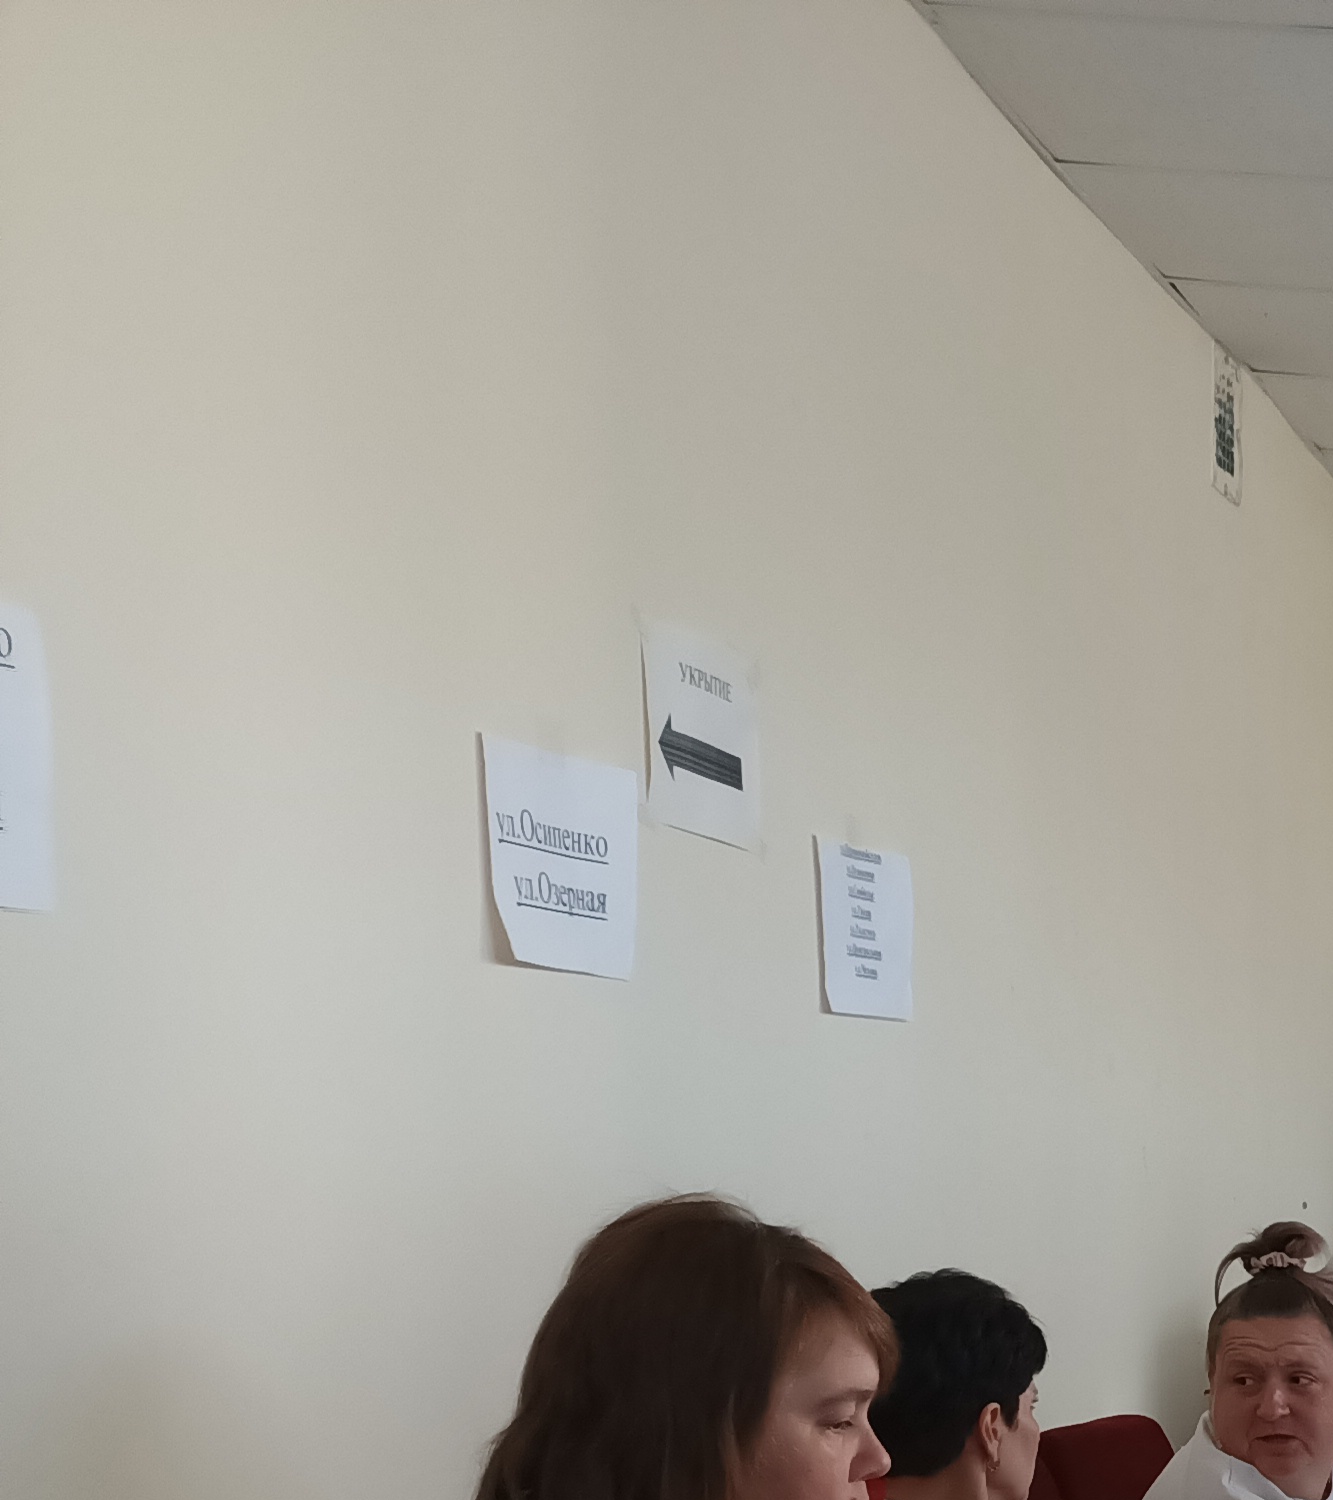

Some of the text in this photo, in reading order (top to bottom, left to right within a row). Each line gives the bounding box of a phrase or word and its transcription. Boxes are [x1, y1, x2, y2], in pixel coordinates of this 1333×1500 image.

[678, 661, 734, 703] УКРЫТИЕ
[495, 808, 609, 859] ул.Осипенко
[513, 871, 608, 915] ул.Озерная
